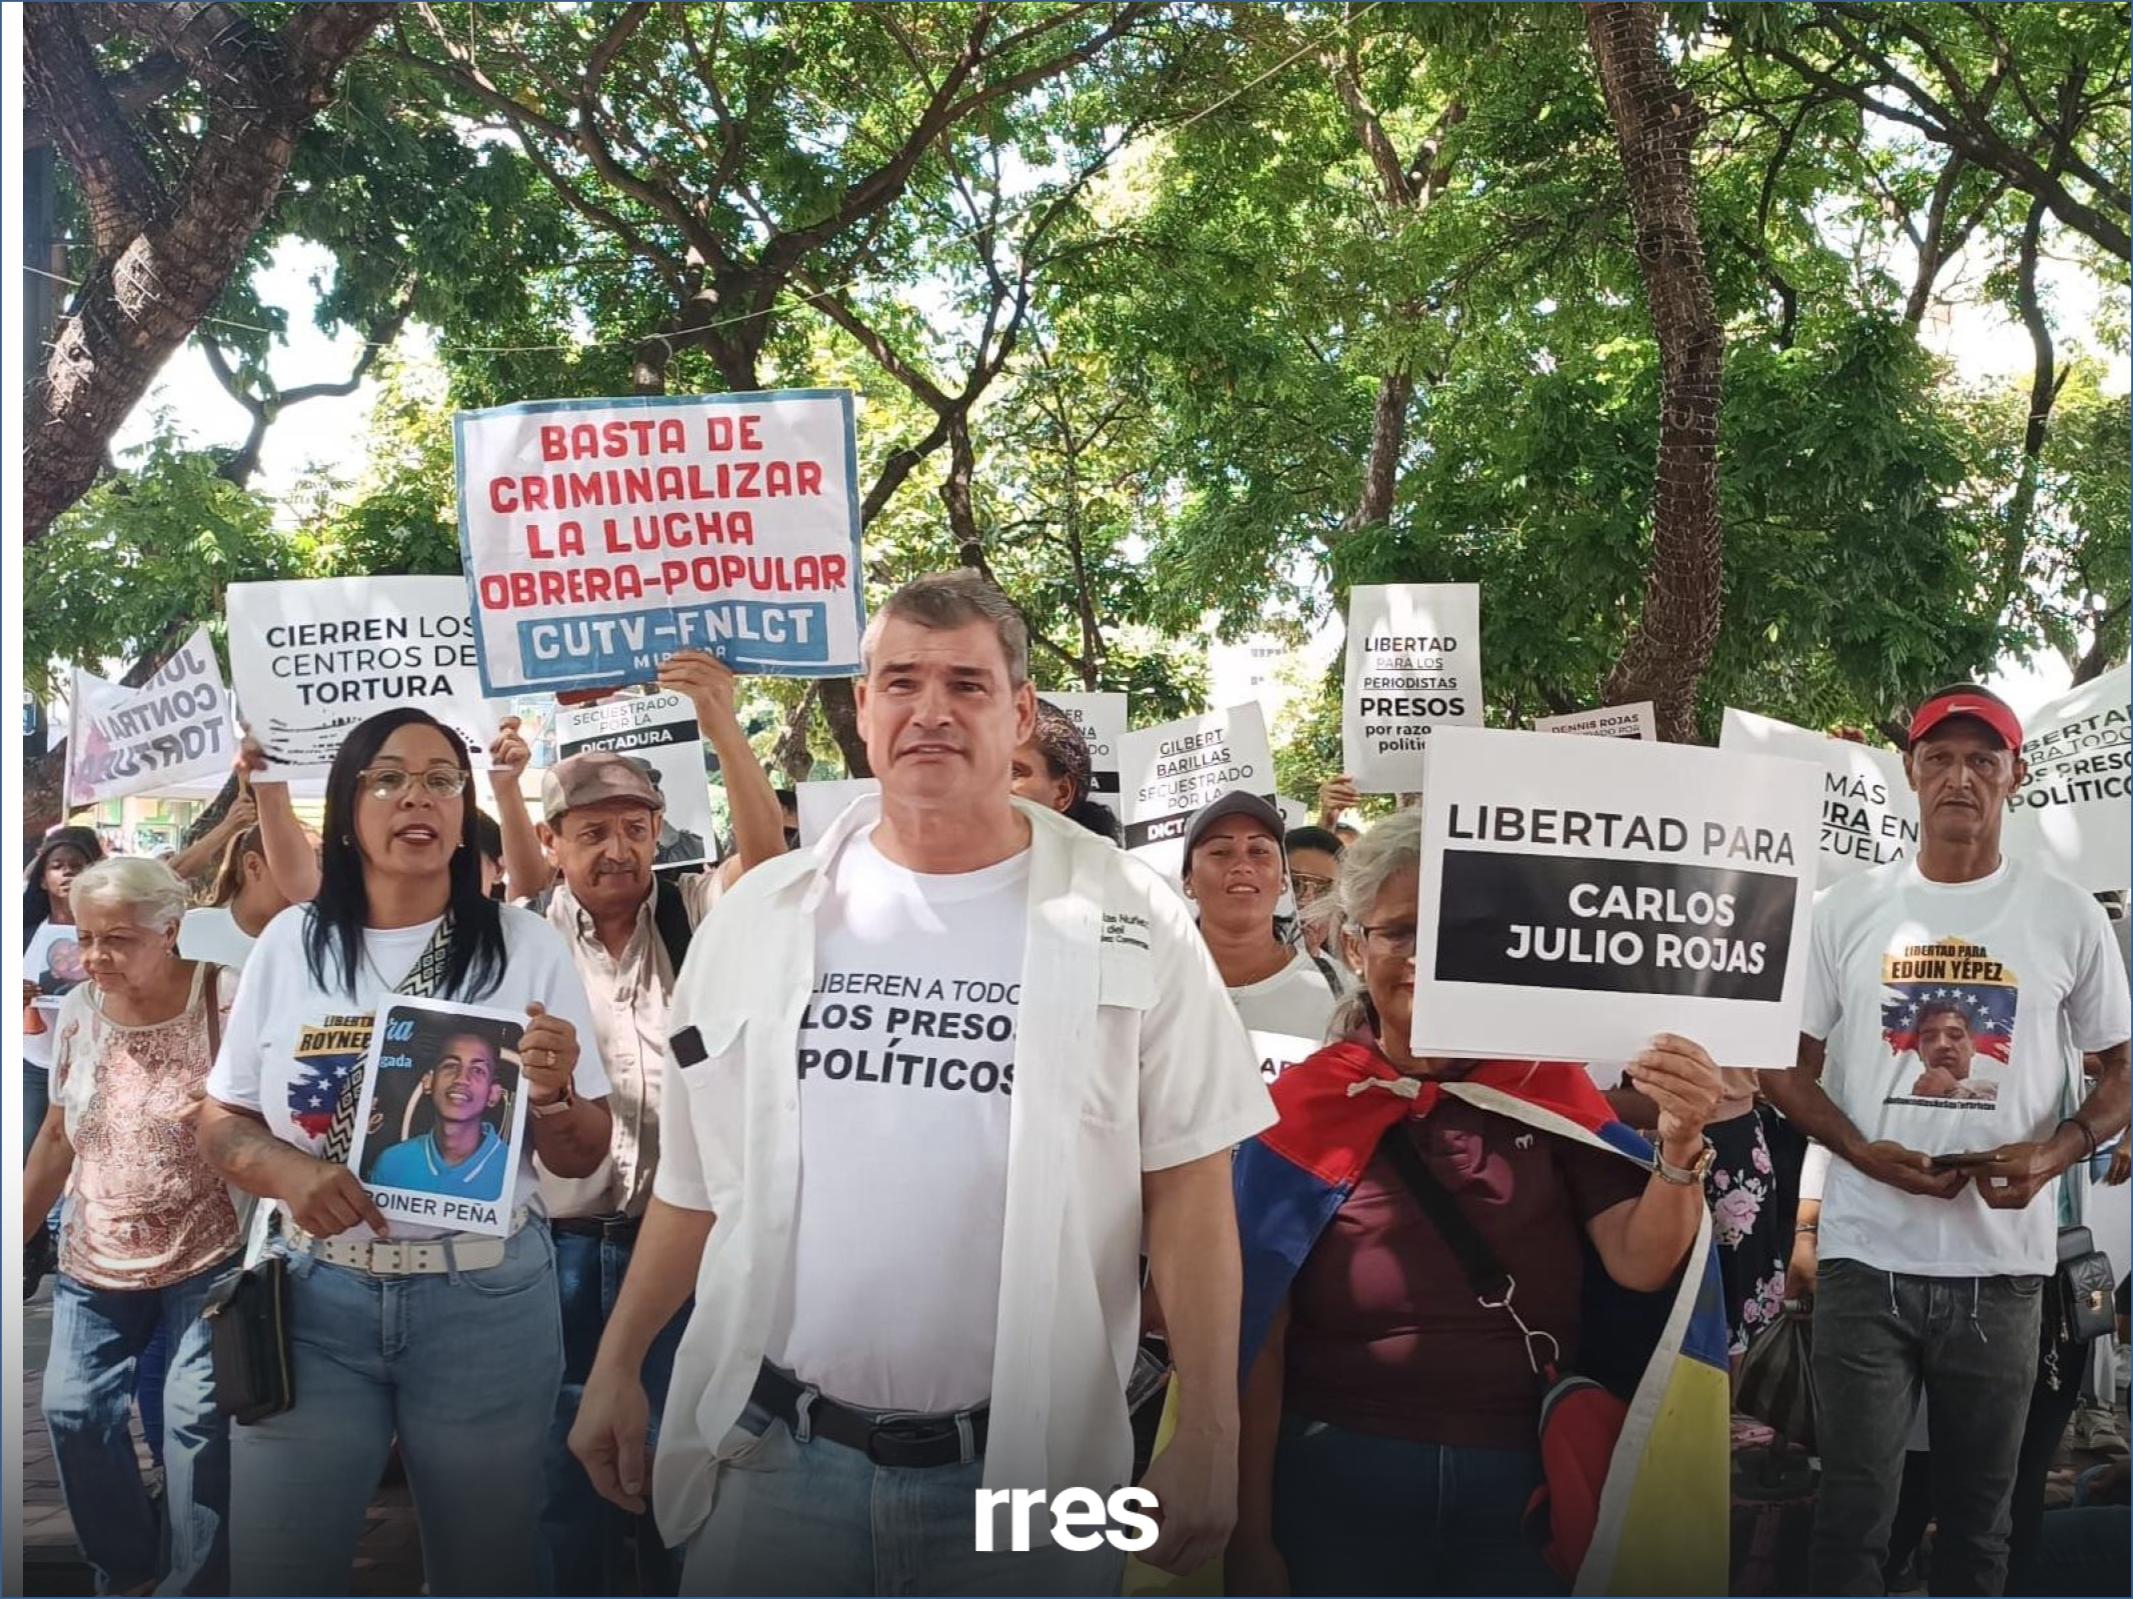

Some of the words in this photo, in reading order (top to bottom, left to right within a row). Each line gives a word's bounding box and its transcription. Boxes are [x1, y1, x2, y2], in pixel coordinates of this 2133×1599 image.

[541, 419, 685, 461] BASTA
[707, 415, 763, 452] DE
[490, 461, 822, 514] CRIMINALIZAR
[527, 521, 585, 559] LA
[604, 511, 754, 553] LUCHA
[480, 554, 847, 610] OBRERA-POPULAR
[266, 617, 408, 648] CIERREN
[1364, 637, 1457, 652] LIBERTAD
[272, 646, 421, 677] CENTROS
[434, 645, 479, 667] DE
[1376, 657, 1413, 668] PARA
[1417, 657, 1443, 669] LOS
[297, 675, 454, 705] TORTURA
[1363, 677, 1457, 689] PERIODISTAS
[573, 696, 679, 726] SECUESTRADO
[634, 714, 652, 726] LA
[1360, 697, 1465, 717] PRESOS
[1365, 725, 1392, 738] por
[1551, 720, 1597, 733] DENNIS
[1600, 713, 1639, 727] ROJAS
[581, 729, 673, 753] DICTADURA
[1159, 729, 1224, 756] GILBERT
[1156, 748, 1232, 777] BARILLAS
[1138, 764, 1254, 802] SECUESTRADO
[1824, 772, 1886, 805] MÁS
[1168, 795, 1200, 809] POR
[1448, 804, 1688, 852] LIBERTAD
[1703, 821, 1796, 866] PARA
[1881, 814, 1919, 843] EN
[1568, 883, 1736, 928] CARLOS
[1505, 924, 1644, 966] JULIO
[1656, 933, 1767, 976] ROJAS
[1905, 945, 1955, 957] LIBERTAD
[1958, 945, 1987, 958] PARA
[1892, 960, 1946, 979] EDUIN
[1951, 957, 2003, 981] YÉPEZ
[925, 979, 944, 1000] A
[800, 1003, 873, 1031] LOS
[886, 1007, 1017, 1042] PRESO
[443, 1202, 498, 1225] PEÑA
